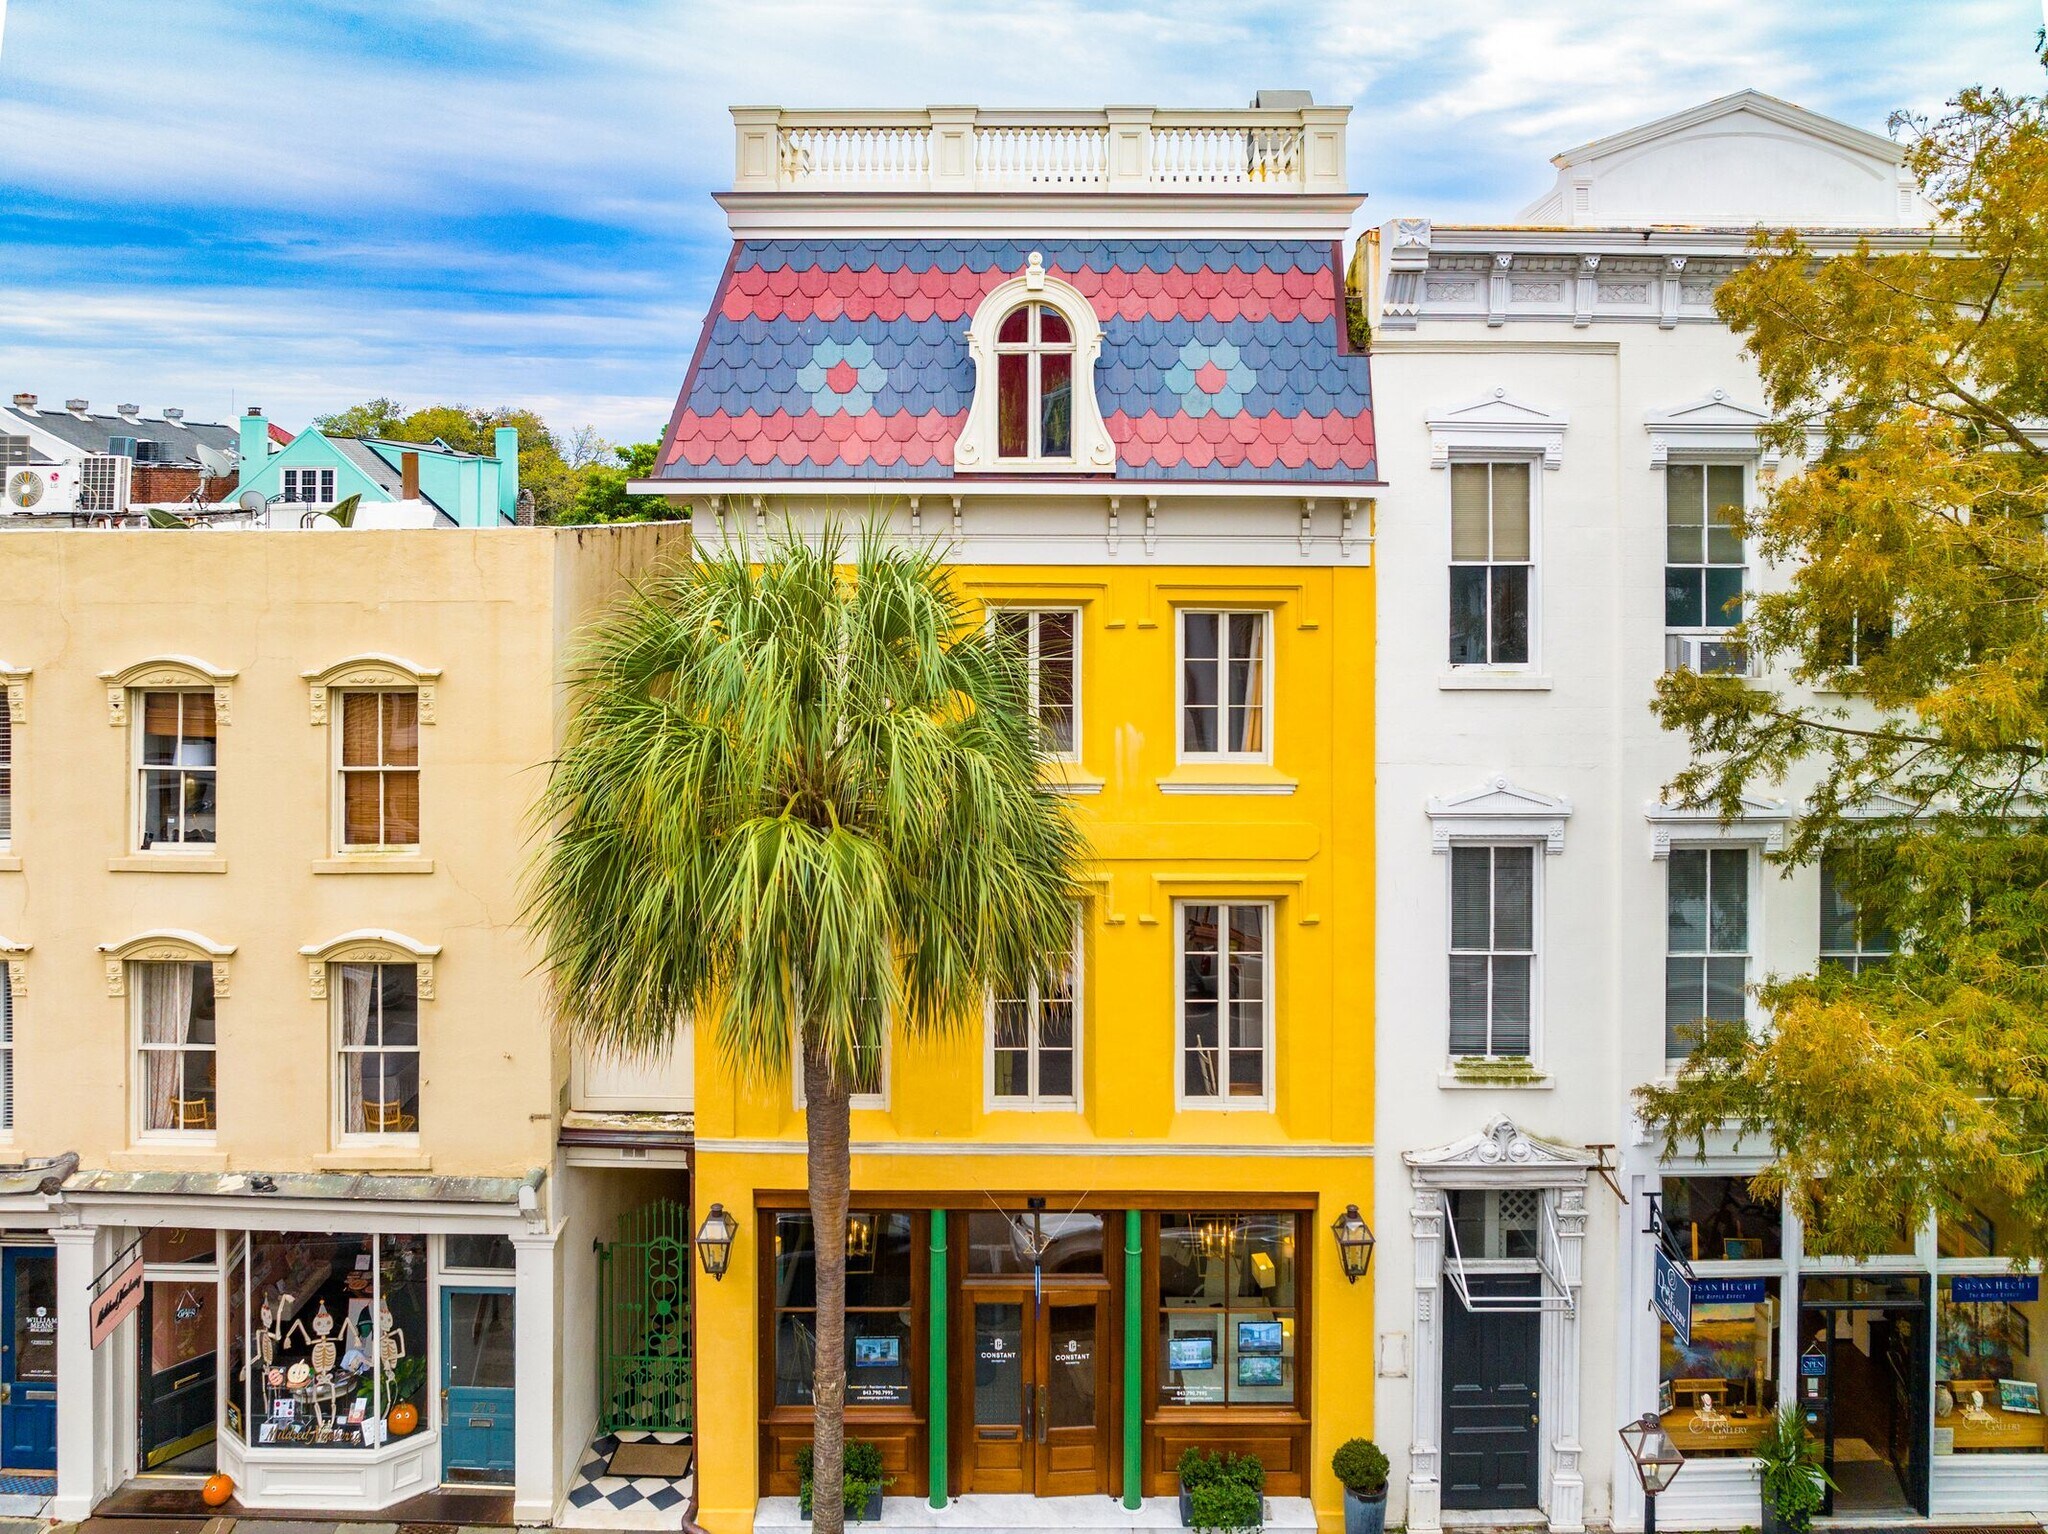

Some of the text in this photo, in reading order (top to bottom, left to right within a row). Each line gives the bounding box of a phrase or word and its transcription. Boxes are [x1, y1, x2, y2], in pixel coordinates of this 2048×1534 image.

[1691, 1282, 1757, 1291] USAN HECHT
[1855, 1283, 1868, 1294] 31
[1957, 1281, 2032, 1290] SUSAN HECHT
[1055, 1353, 1090, 1361] CONSTANT
[1712, 1424, 1747, 1434] GALLERY
